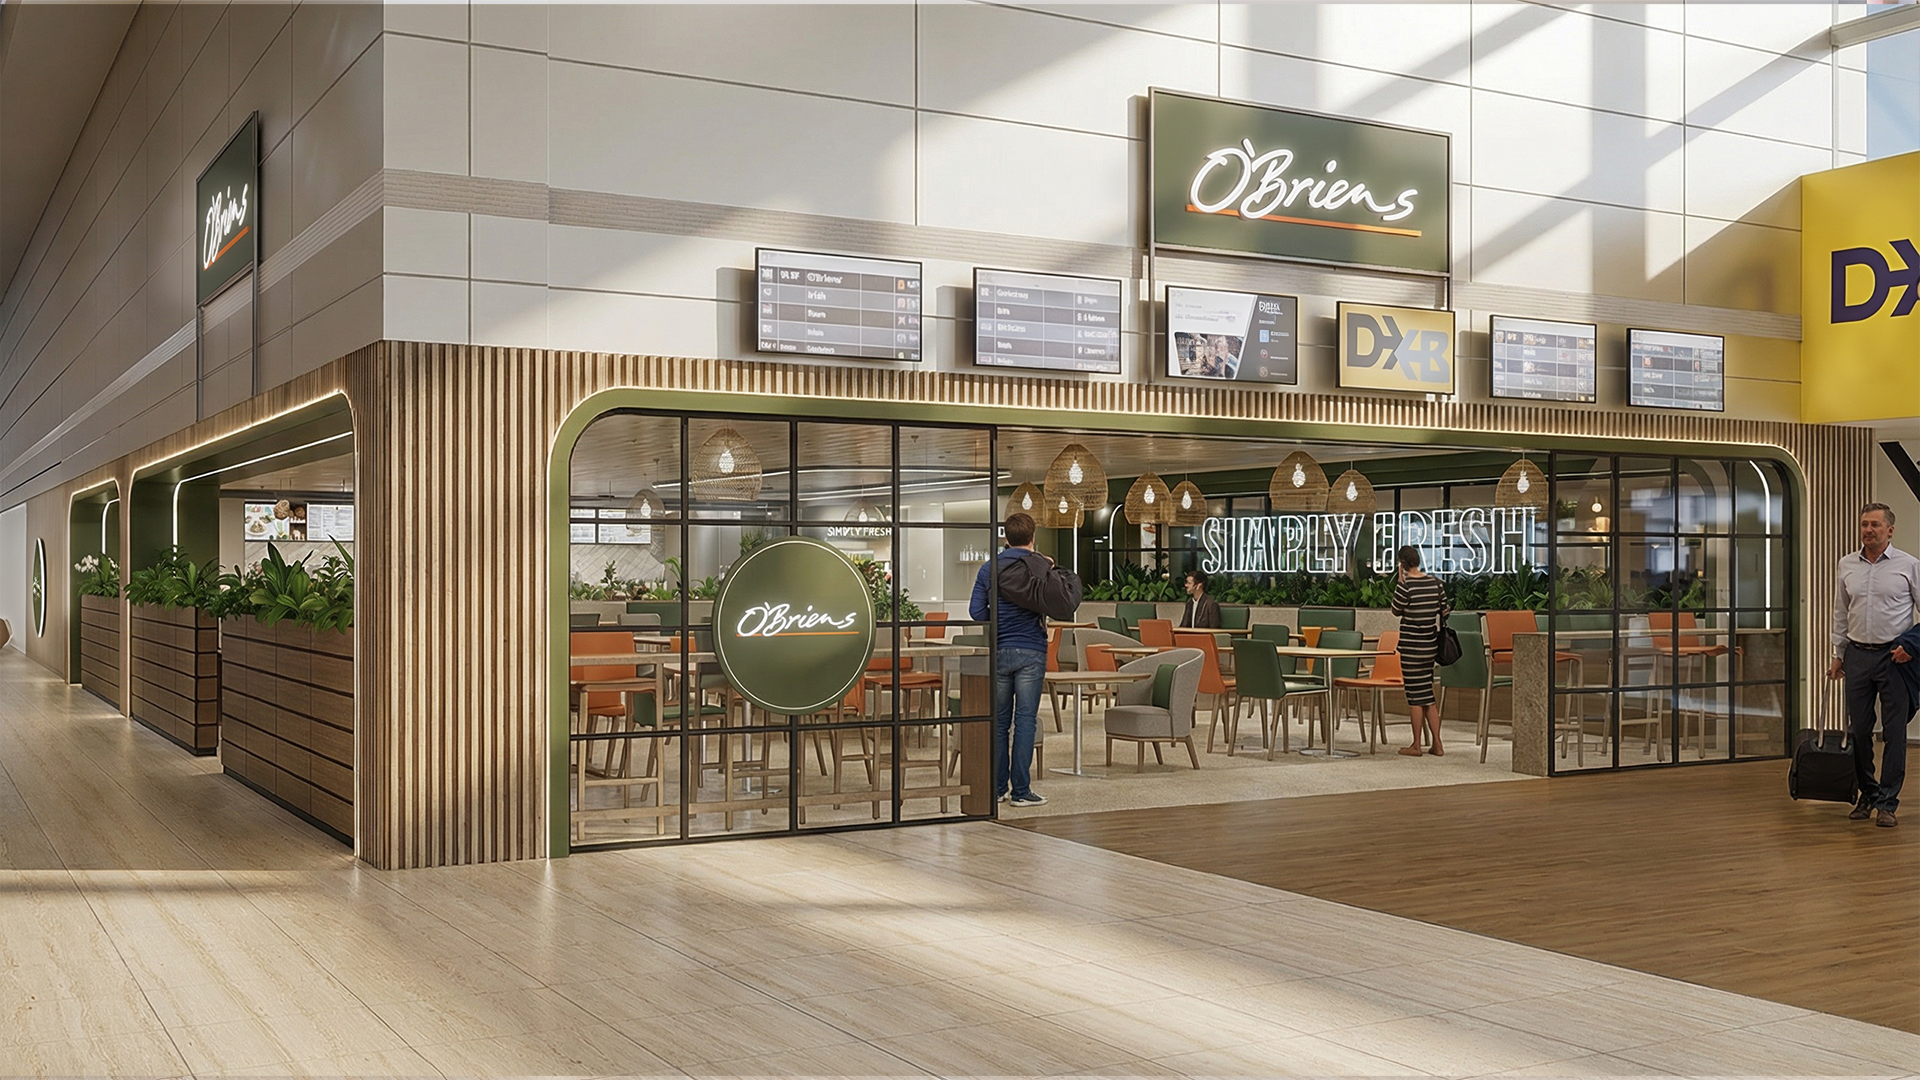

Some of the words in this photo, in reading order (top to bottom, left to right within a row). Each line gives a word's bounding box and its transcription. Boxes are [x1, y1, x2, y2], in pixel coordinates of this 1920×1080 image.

[1190, 138, 1419, 220] O'Briens
[1346, 312, 1450, 383] DXB
[736, 602, 857, 637] O'Briens
